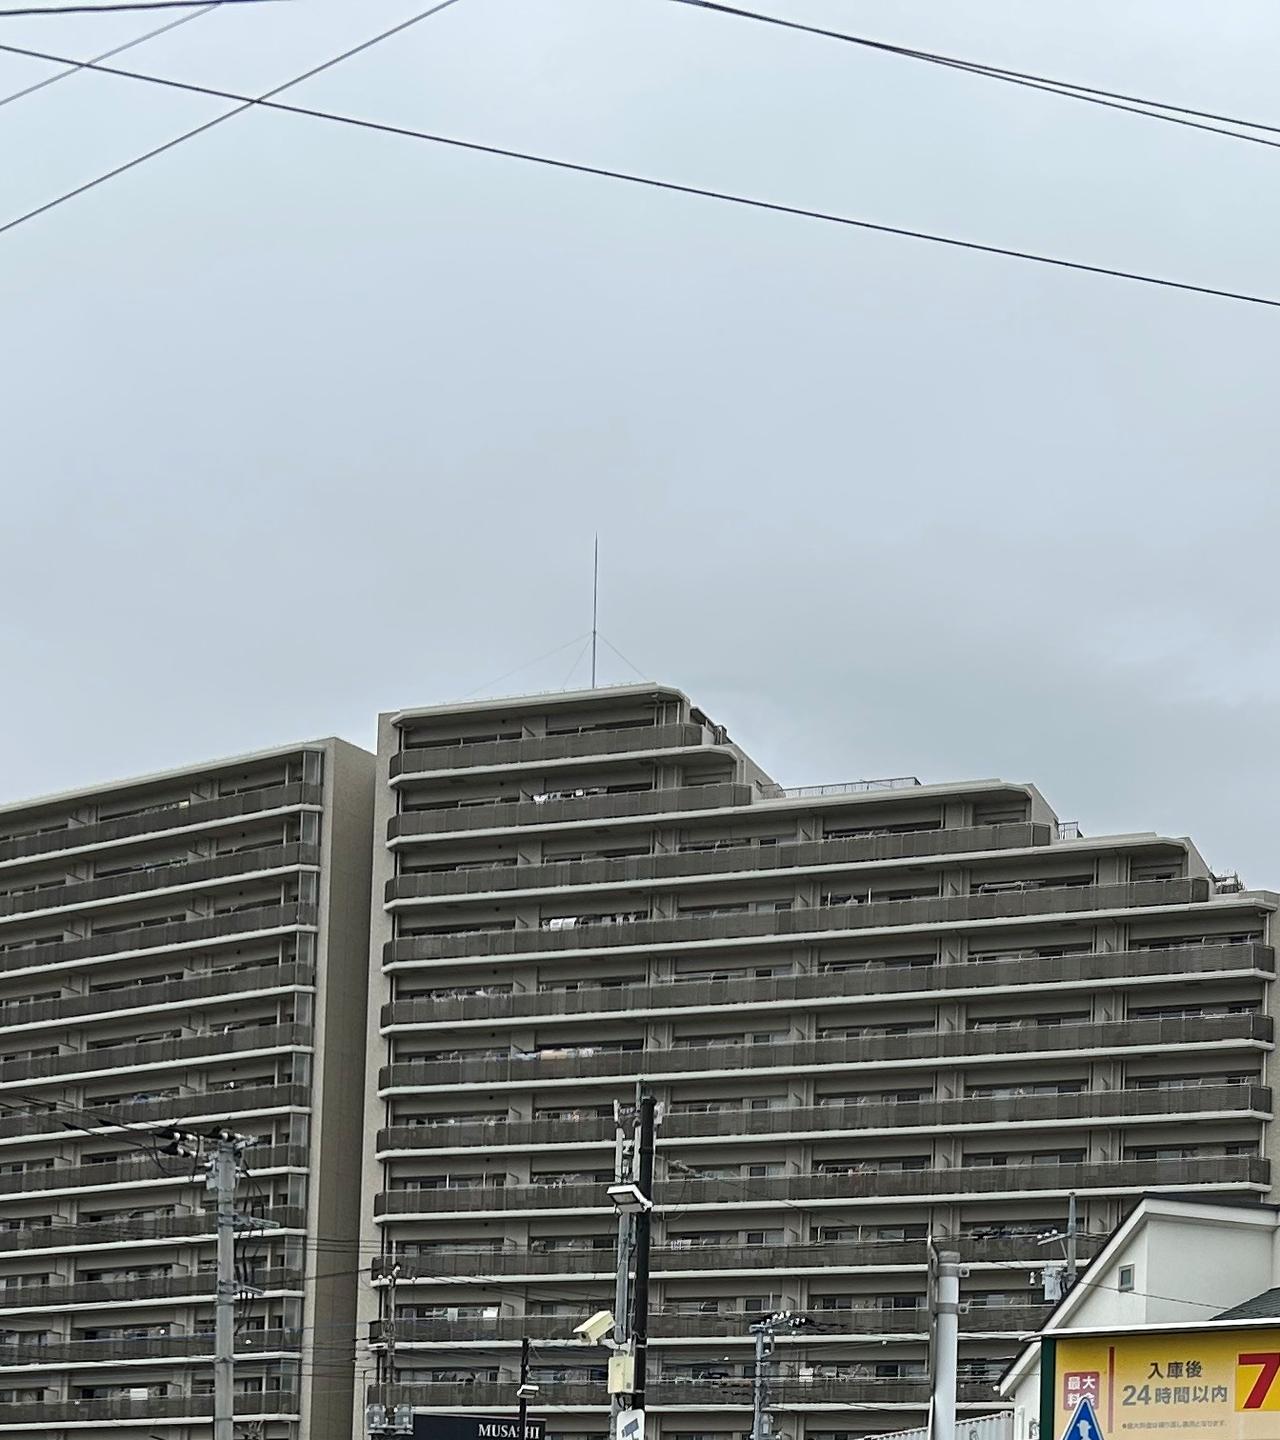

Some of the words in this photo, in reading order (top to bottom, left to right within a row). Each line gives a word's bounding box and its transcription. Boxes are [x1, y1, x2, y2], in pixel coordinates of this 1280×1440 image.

[1147, 1360, 1203, 1379] 入庫後
[1067, 1375, 1096, 1390] 最大
[1122, 1384, 1228, 1407] 24時間以内
